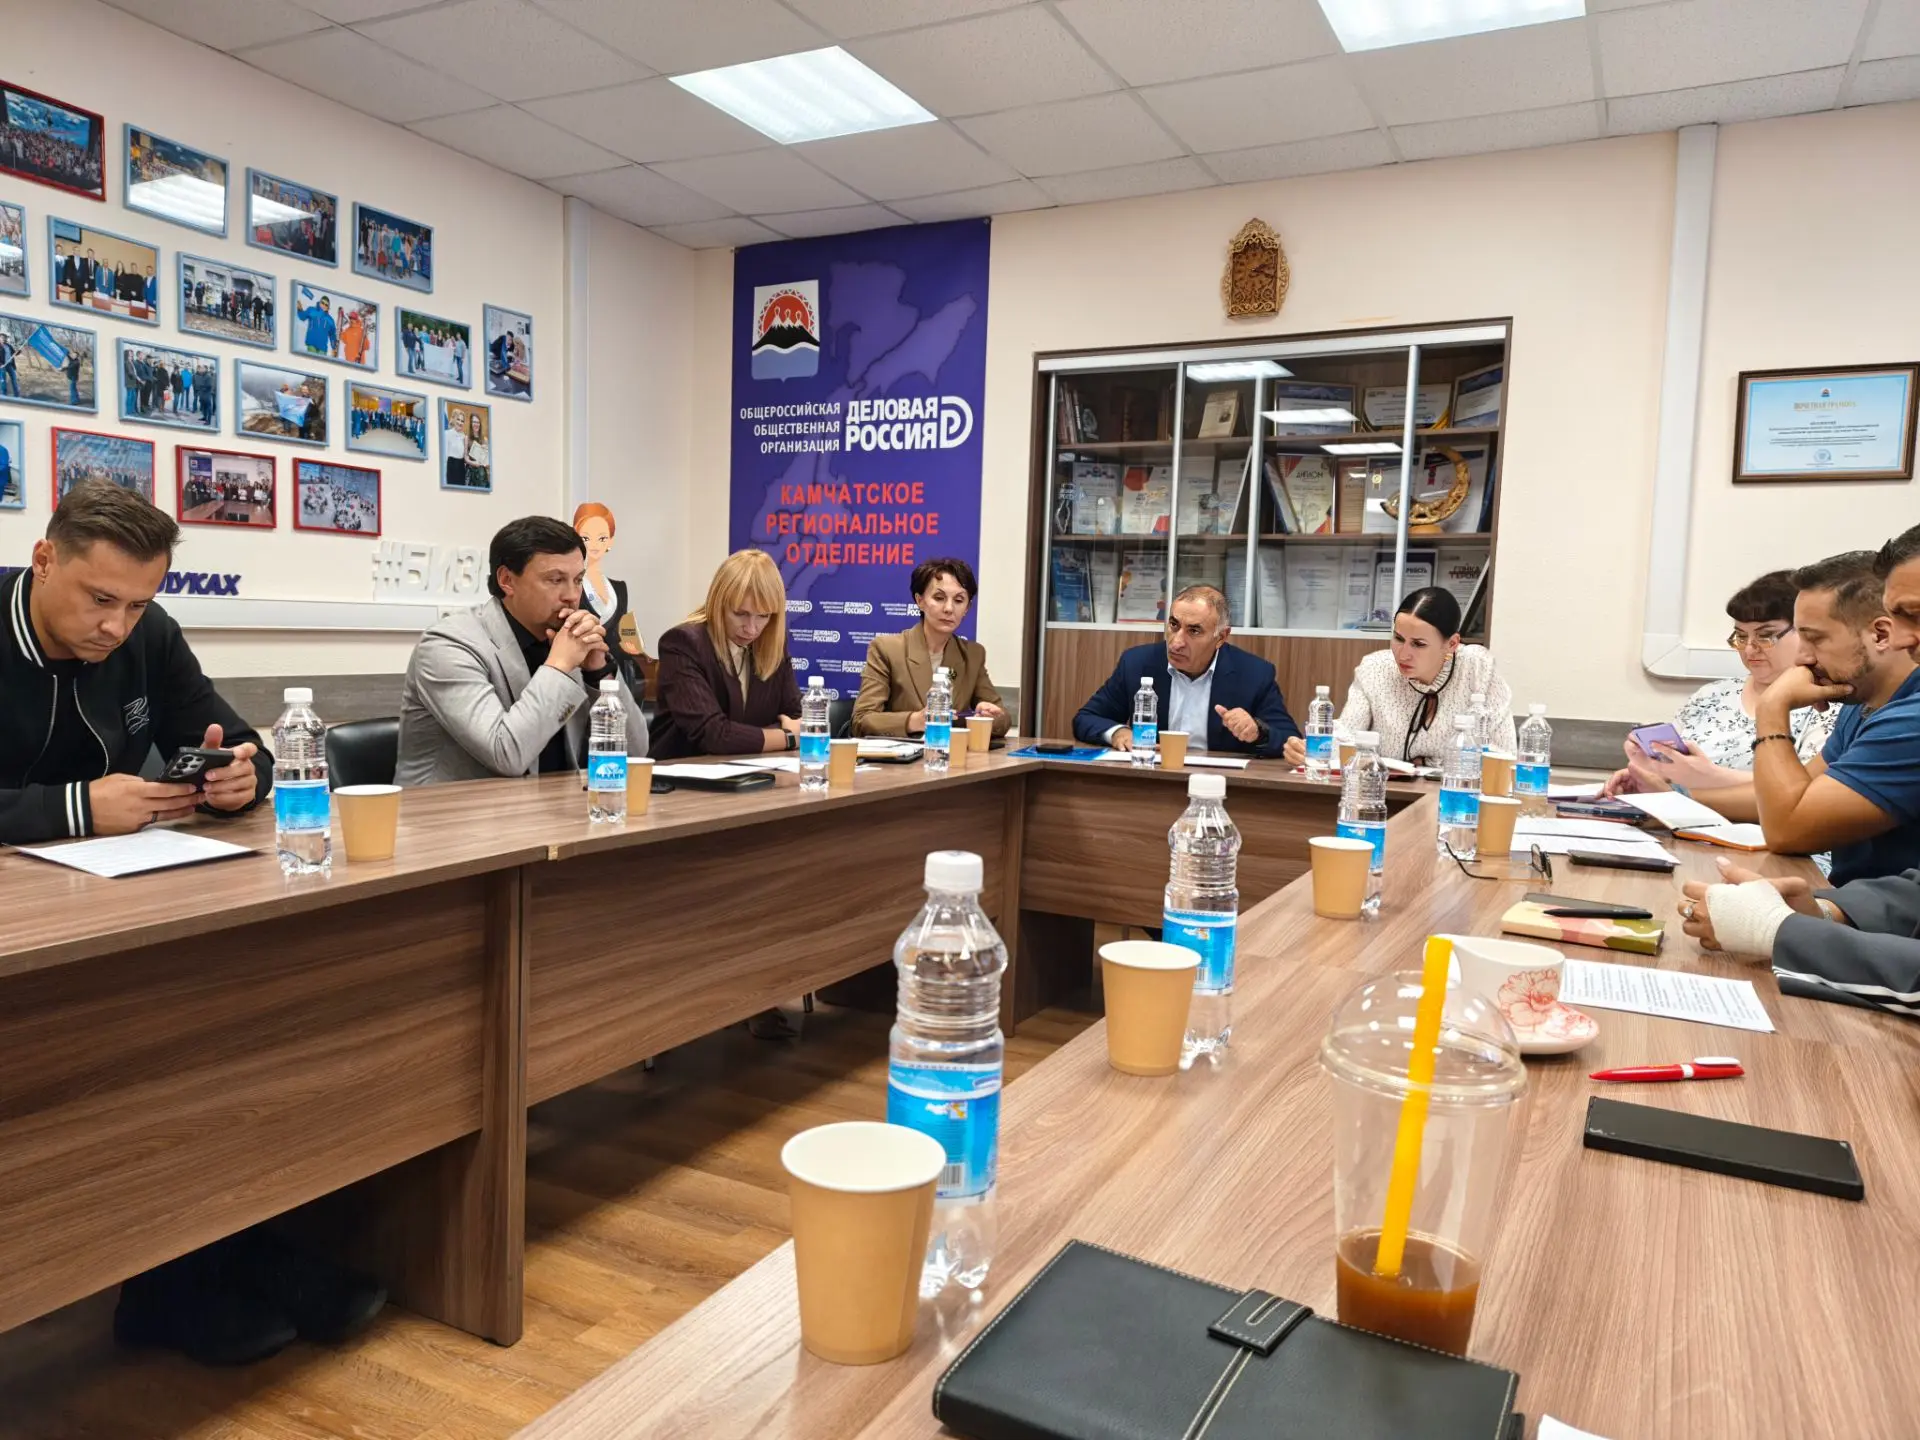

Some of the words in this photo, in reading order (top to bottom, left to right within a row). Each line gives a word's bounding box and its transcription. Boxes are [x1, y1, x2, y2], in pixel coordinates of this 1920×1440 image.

[740, 402, 840, 420] ОБЩЕРОССИЙСКАЯ
[846, 397, 938, 424] ДЕЛОВАЯ
[753, 421, 840, 437] ОБЩЕСТВЕННАЯ
[845, 422, 938, 451] РОССИЯ
[760, 439, 840, 454] ОРГАНИЗАЦИЯ
[780, 482, 925, 505] КАМЧАТСКОЕ
[766, 513, 939, 535] РЕГИОНАЛЬНОЕ
[786, 543, 915, 567] ОТДЕЛЕНИЕ
[372, 541, 490, 598] #БИЗ
